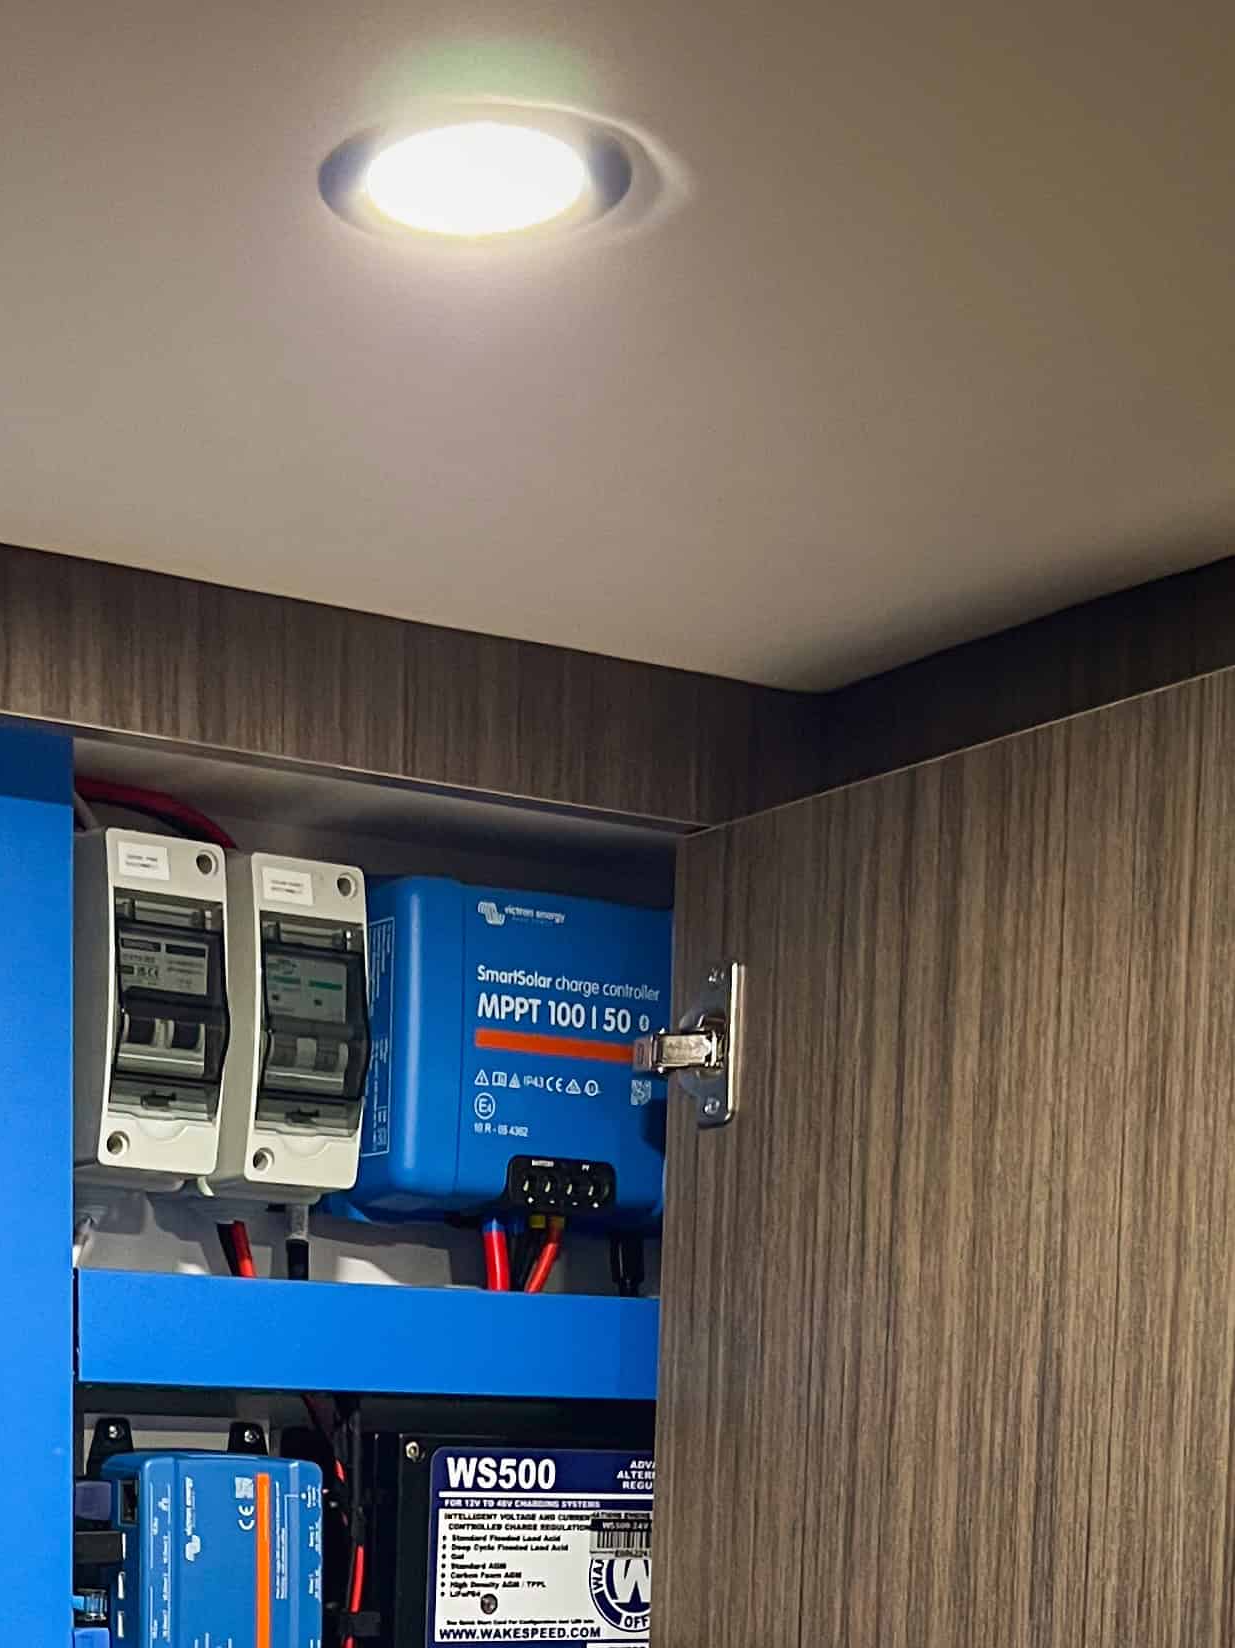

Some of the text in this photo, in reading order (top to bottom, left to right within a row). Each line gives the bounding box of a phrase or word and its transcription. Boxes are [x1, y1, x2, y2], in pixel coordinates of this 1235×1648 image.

[478, 965, 660, 1001] SmartSolar charge controller
[478, 992, 542, 1024] MPPT
[548, 1000, 585, 1028] 100
[603, 1008, 631, 1033] 50
[446, 1457, 556, 1489] WS500
[444, 1500, 463, 1508] FOR
[483, 1500, 494, 1508] TO
[515, 1500, 559, 1508] CHARGING
[439, 1627, 601, 1640] WWW.WAKESPEED.COM
